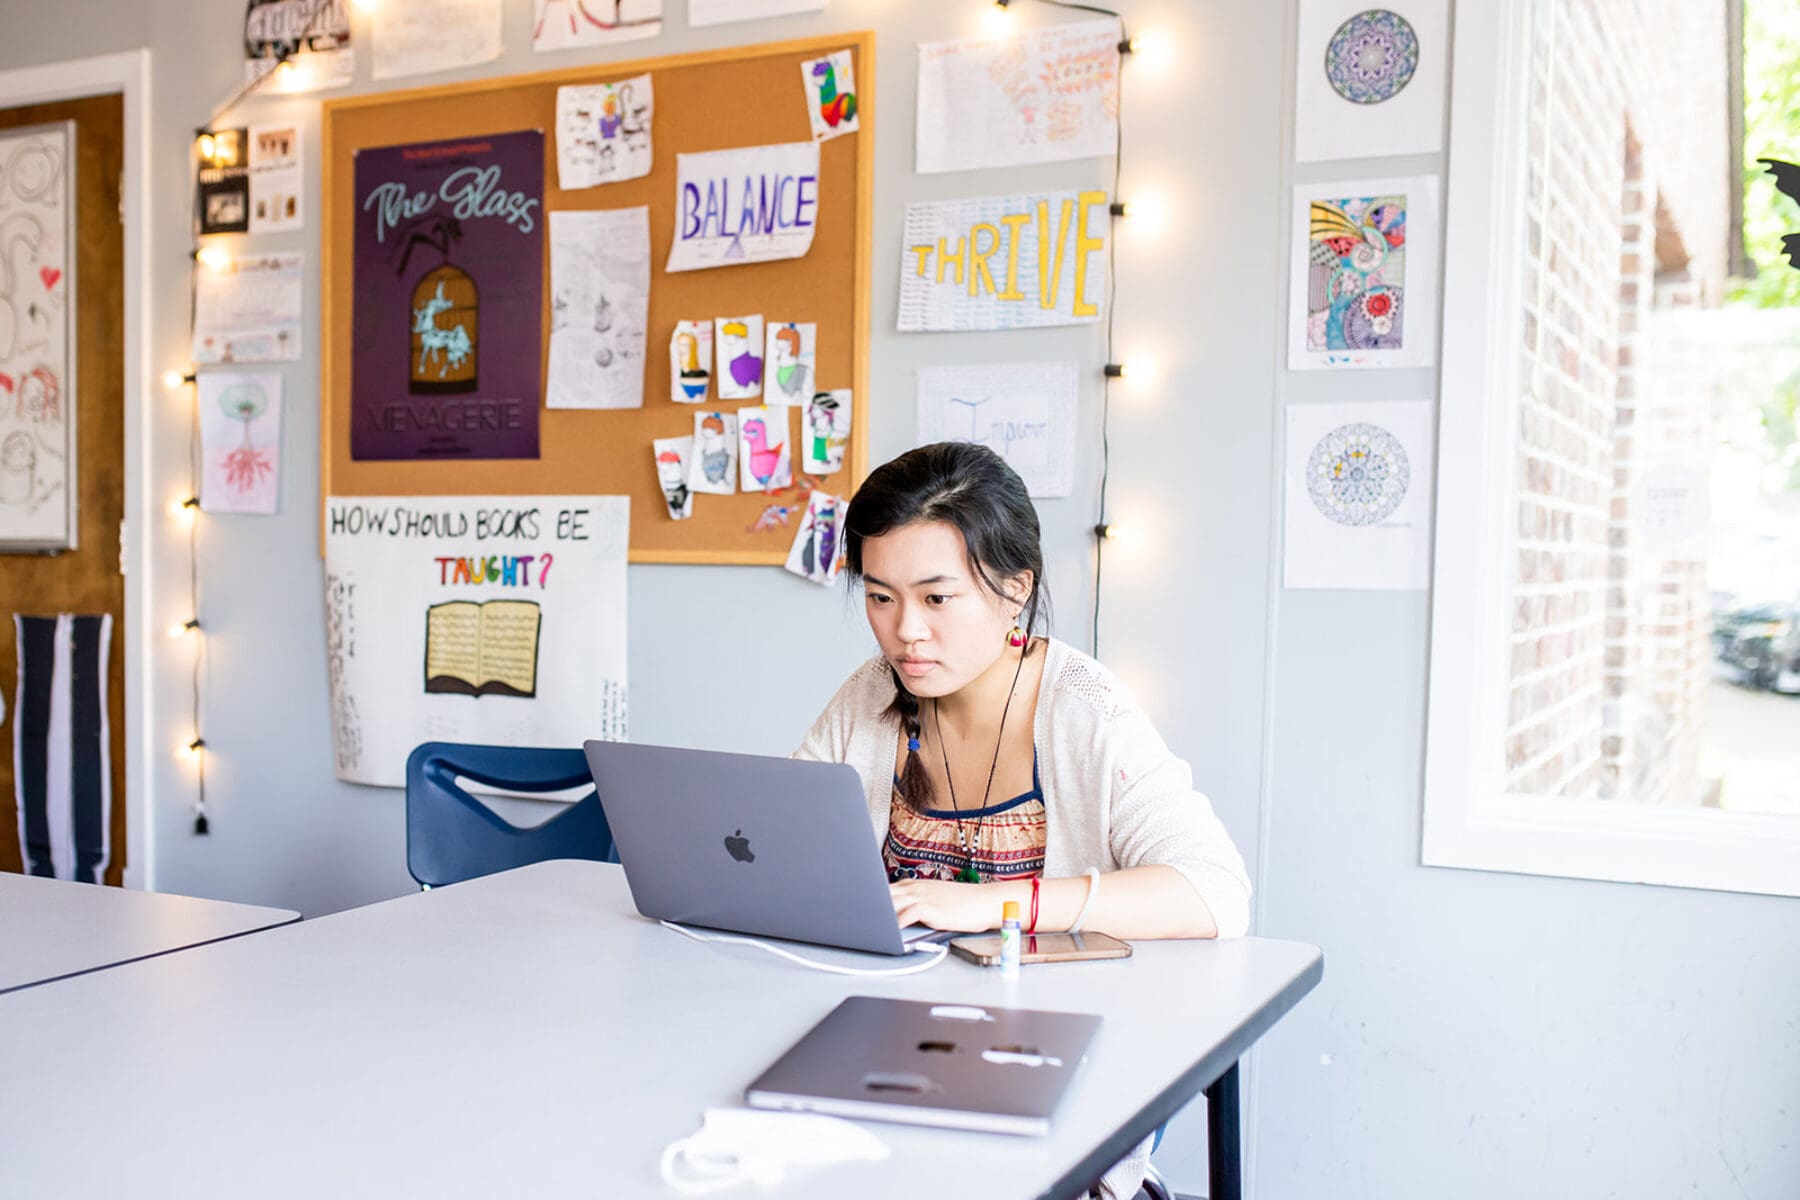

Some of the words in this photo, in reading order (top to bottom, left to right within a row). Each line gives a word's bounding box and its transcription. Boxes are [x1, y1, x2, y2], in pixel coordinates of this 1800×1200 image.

[363, 181, 437, 242] The
[439, 164, 539, 234] Glass
[682, 173, 817, 240] BALANCE
[910, 190, 1108, 317] THRIVE
[367, 398, 521, 433] MENAGERIE
[331, 506, 388, 536] HOW
[388, 507, 468, 539] SHOULD
[476, 508, 540, 540] BOOKS
[556, 509, 590, 540] BE
